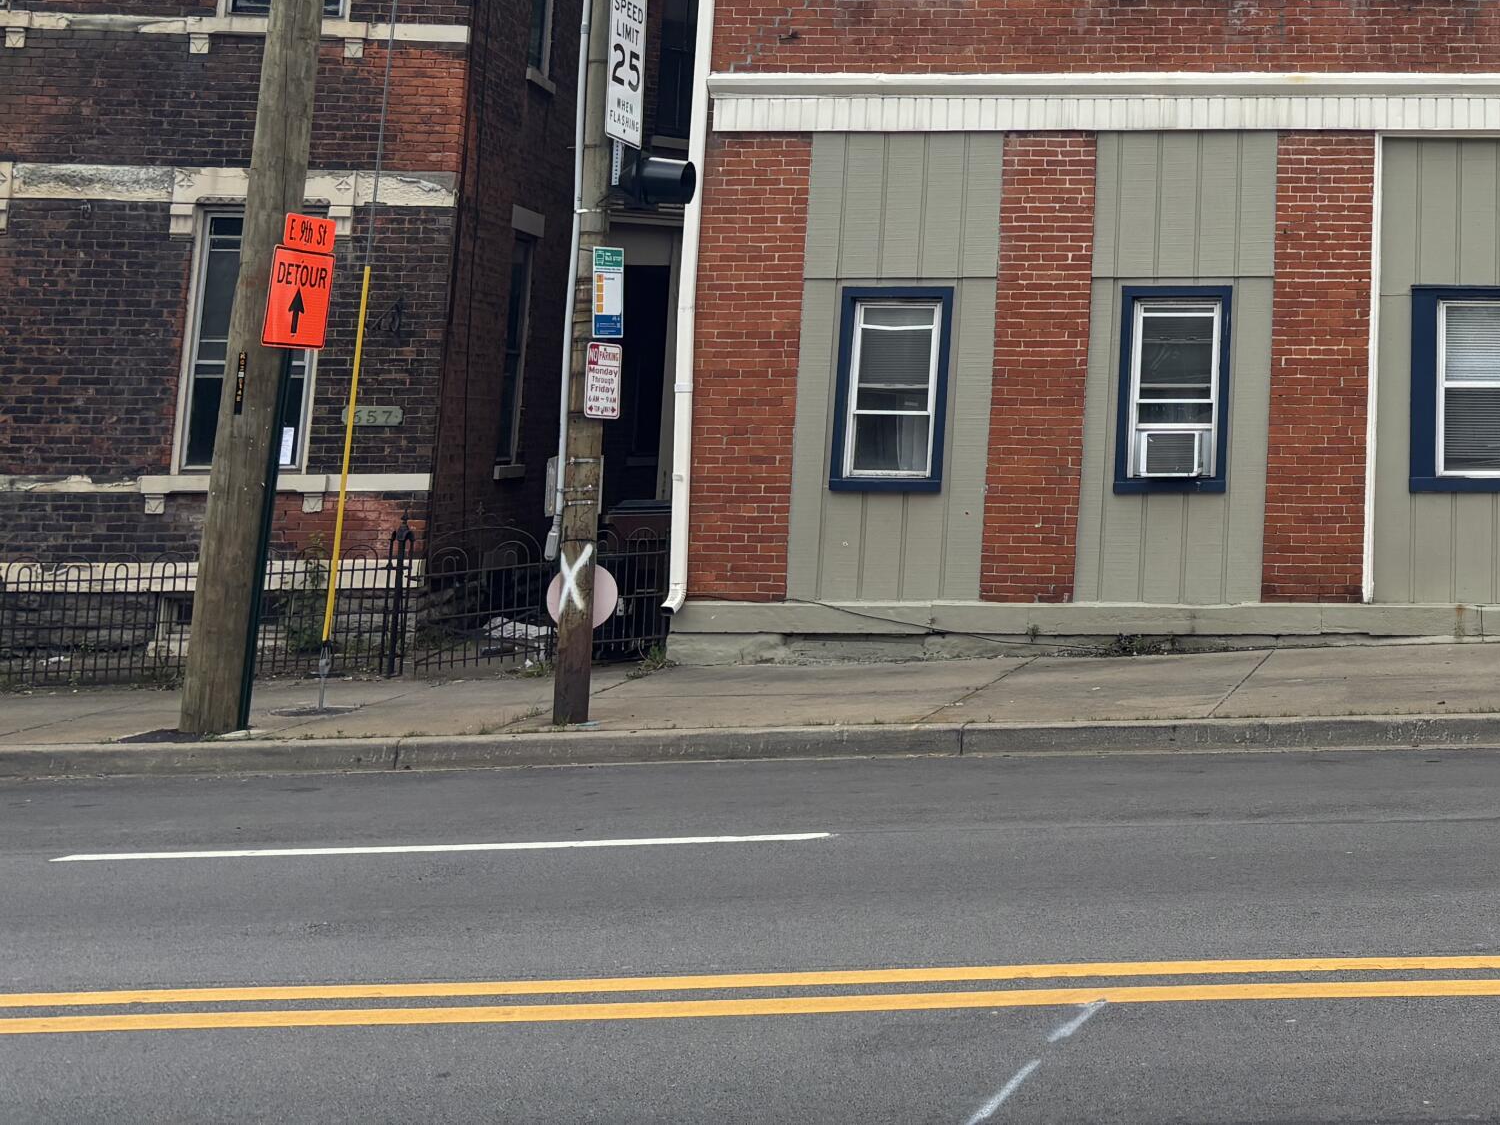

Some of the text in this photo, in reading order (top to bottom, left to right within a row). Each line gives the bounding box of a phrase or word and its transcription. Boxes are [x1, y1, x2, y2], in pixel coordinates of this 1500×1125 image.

[616, 18, 640, 46] LIMIT
[611, 43, 640, 93] 25
[616, 96, 634, 114] WHEN
[609, 109, 640, 133] FLASHING
[289, 218, 327, 247] E. 9th St
[276, 261, 328, 289] DETOUR
[589, 348, 618, 362] NO PARKING
[589, 365, 618, 377] Monday
[592, 375, 614, 386] Through
[590, 383, 615, 395] Friday
